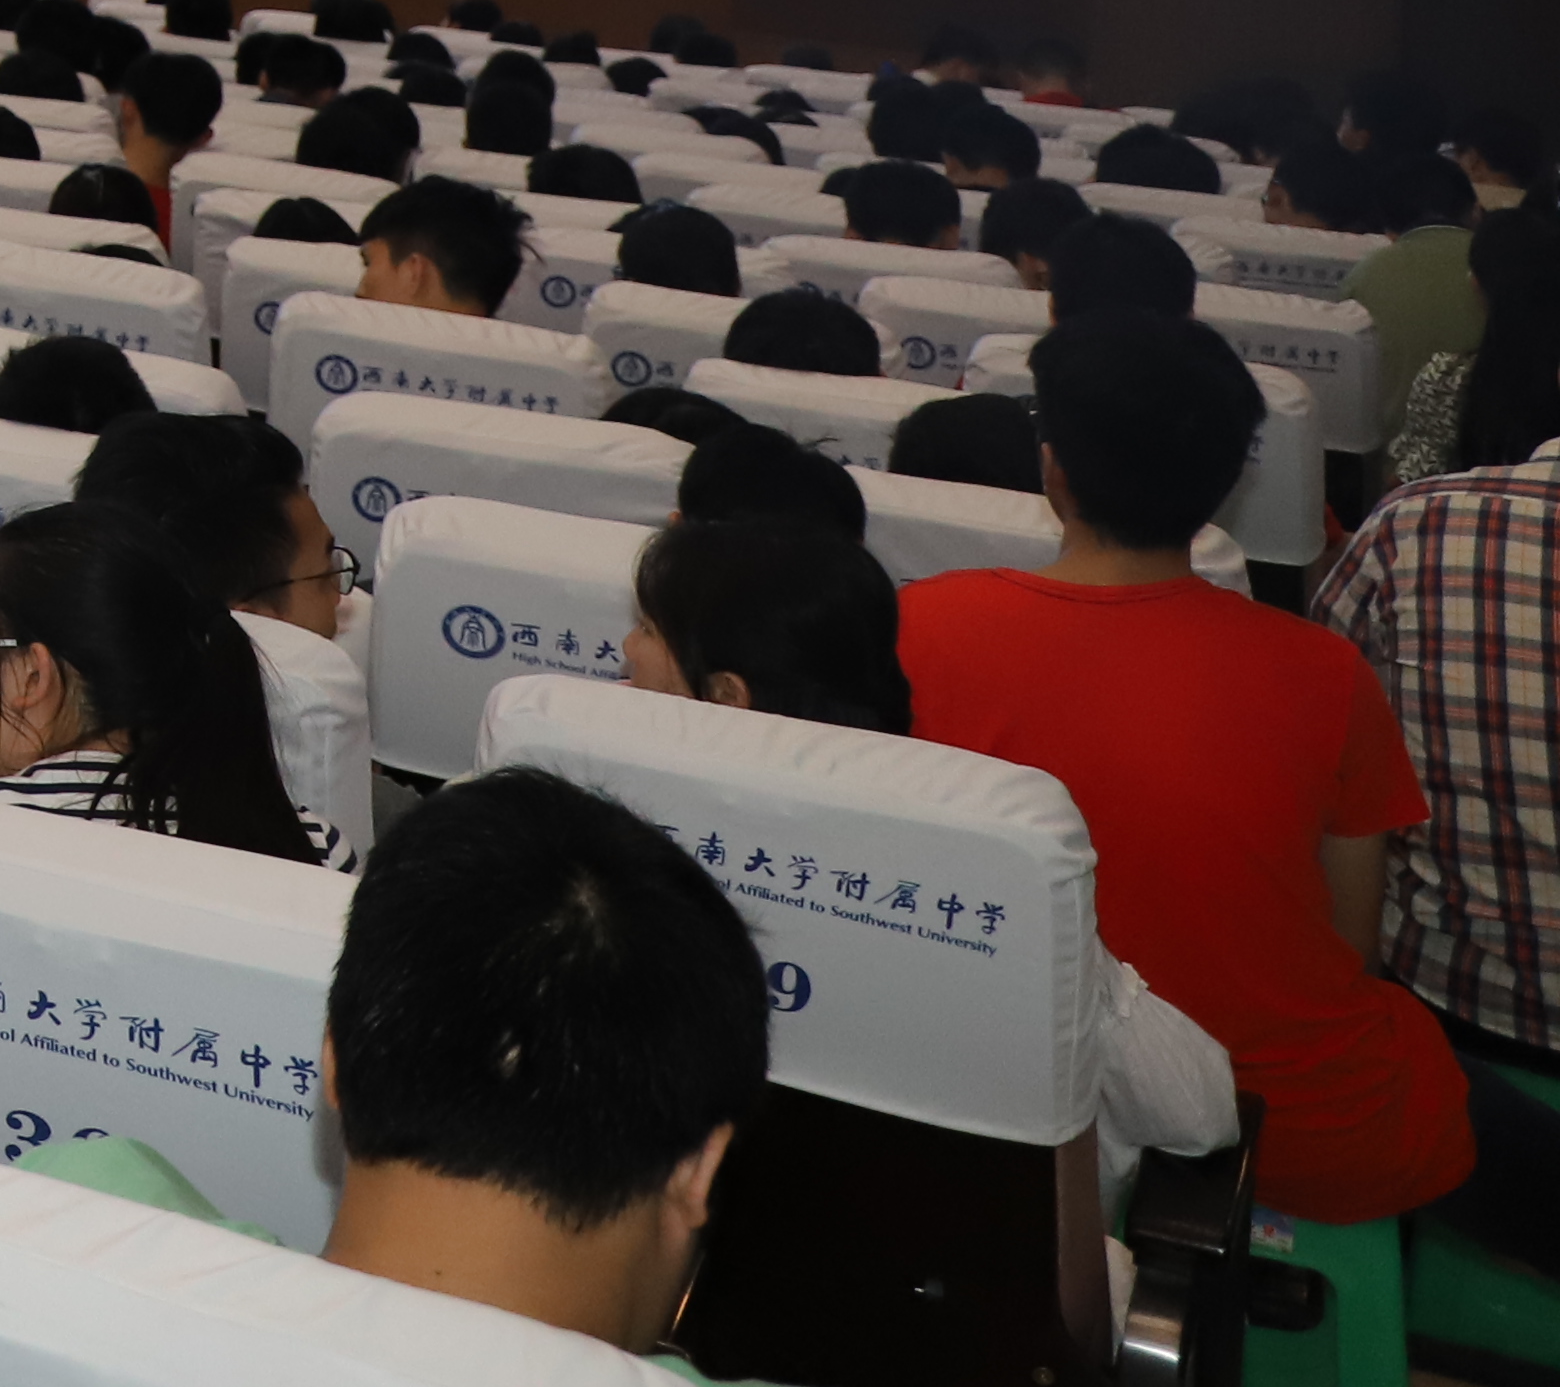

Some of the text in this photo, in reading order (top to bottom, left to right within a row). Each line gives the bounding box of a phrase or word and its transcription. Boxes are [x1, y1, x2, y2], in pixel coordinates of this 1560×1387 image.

[735, 881, 807, 911] Affiliated
[829, 902, 914, 937] Southwest
[917, 925, 998, 959] University
[19, 1029, 98, 1067] Affiliated
[124, 1056, 220, 1096] Southwest
[223, 1084, 316, 1123] University
